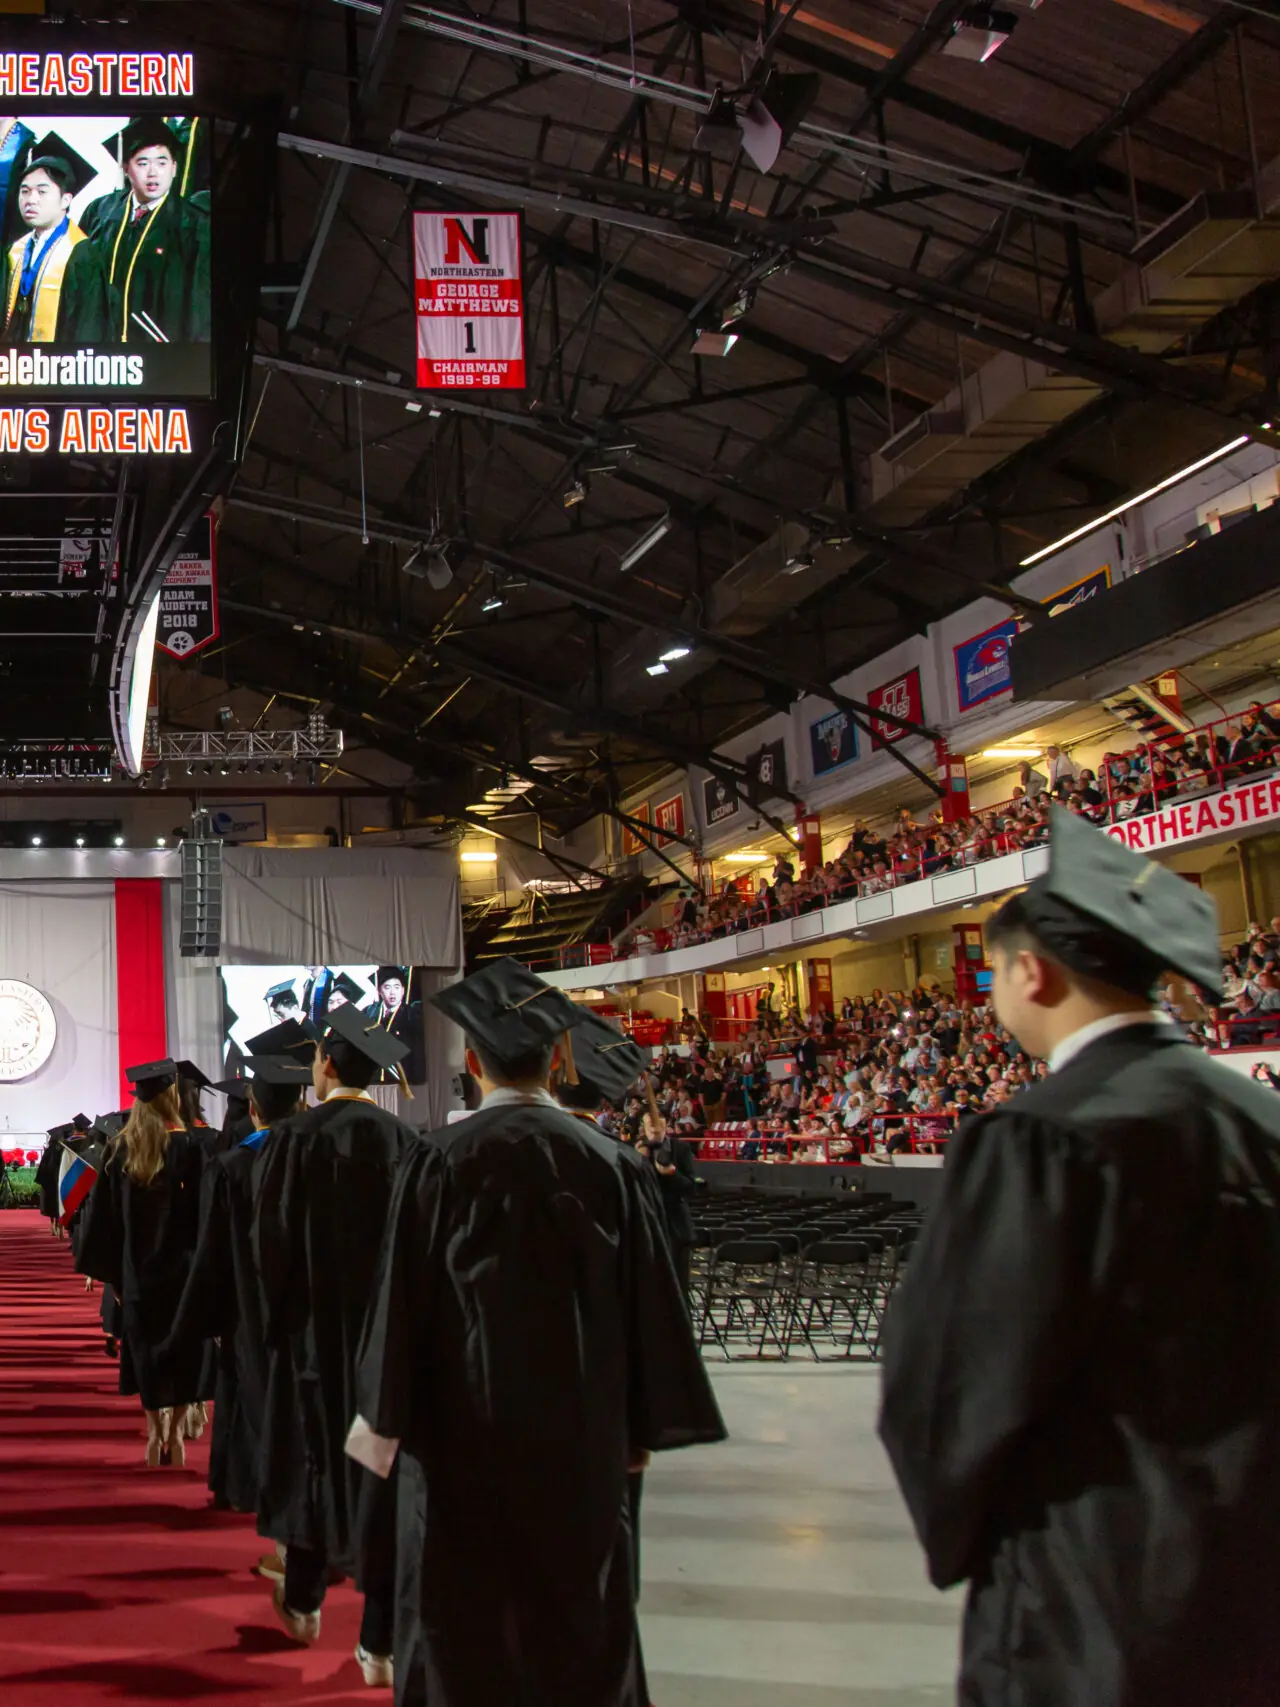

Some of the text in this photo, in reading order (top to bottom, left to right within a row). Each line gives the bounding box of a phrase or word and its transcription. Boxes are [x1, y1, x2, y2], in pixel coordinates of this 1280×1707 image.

[444, 218, 489, 264] N
[430, 267, 504, 277] NORTHEASTERN
[437, 284, 499, 298] GEORGE
[418, 298, 519, 313] MATTHEWS
[464, 322, 476, 353] 1
[433, 363, 508, 373] CHAIRMAN
[59, 409, 192, 454] ARENA
[163, 591, 195, 600] ADAM
[159, 601, 208, 611] AUDETTE
[163, 614, 198, 628] 2018
[1108, 779, 1280, 850] ORTHEASTER
